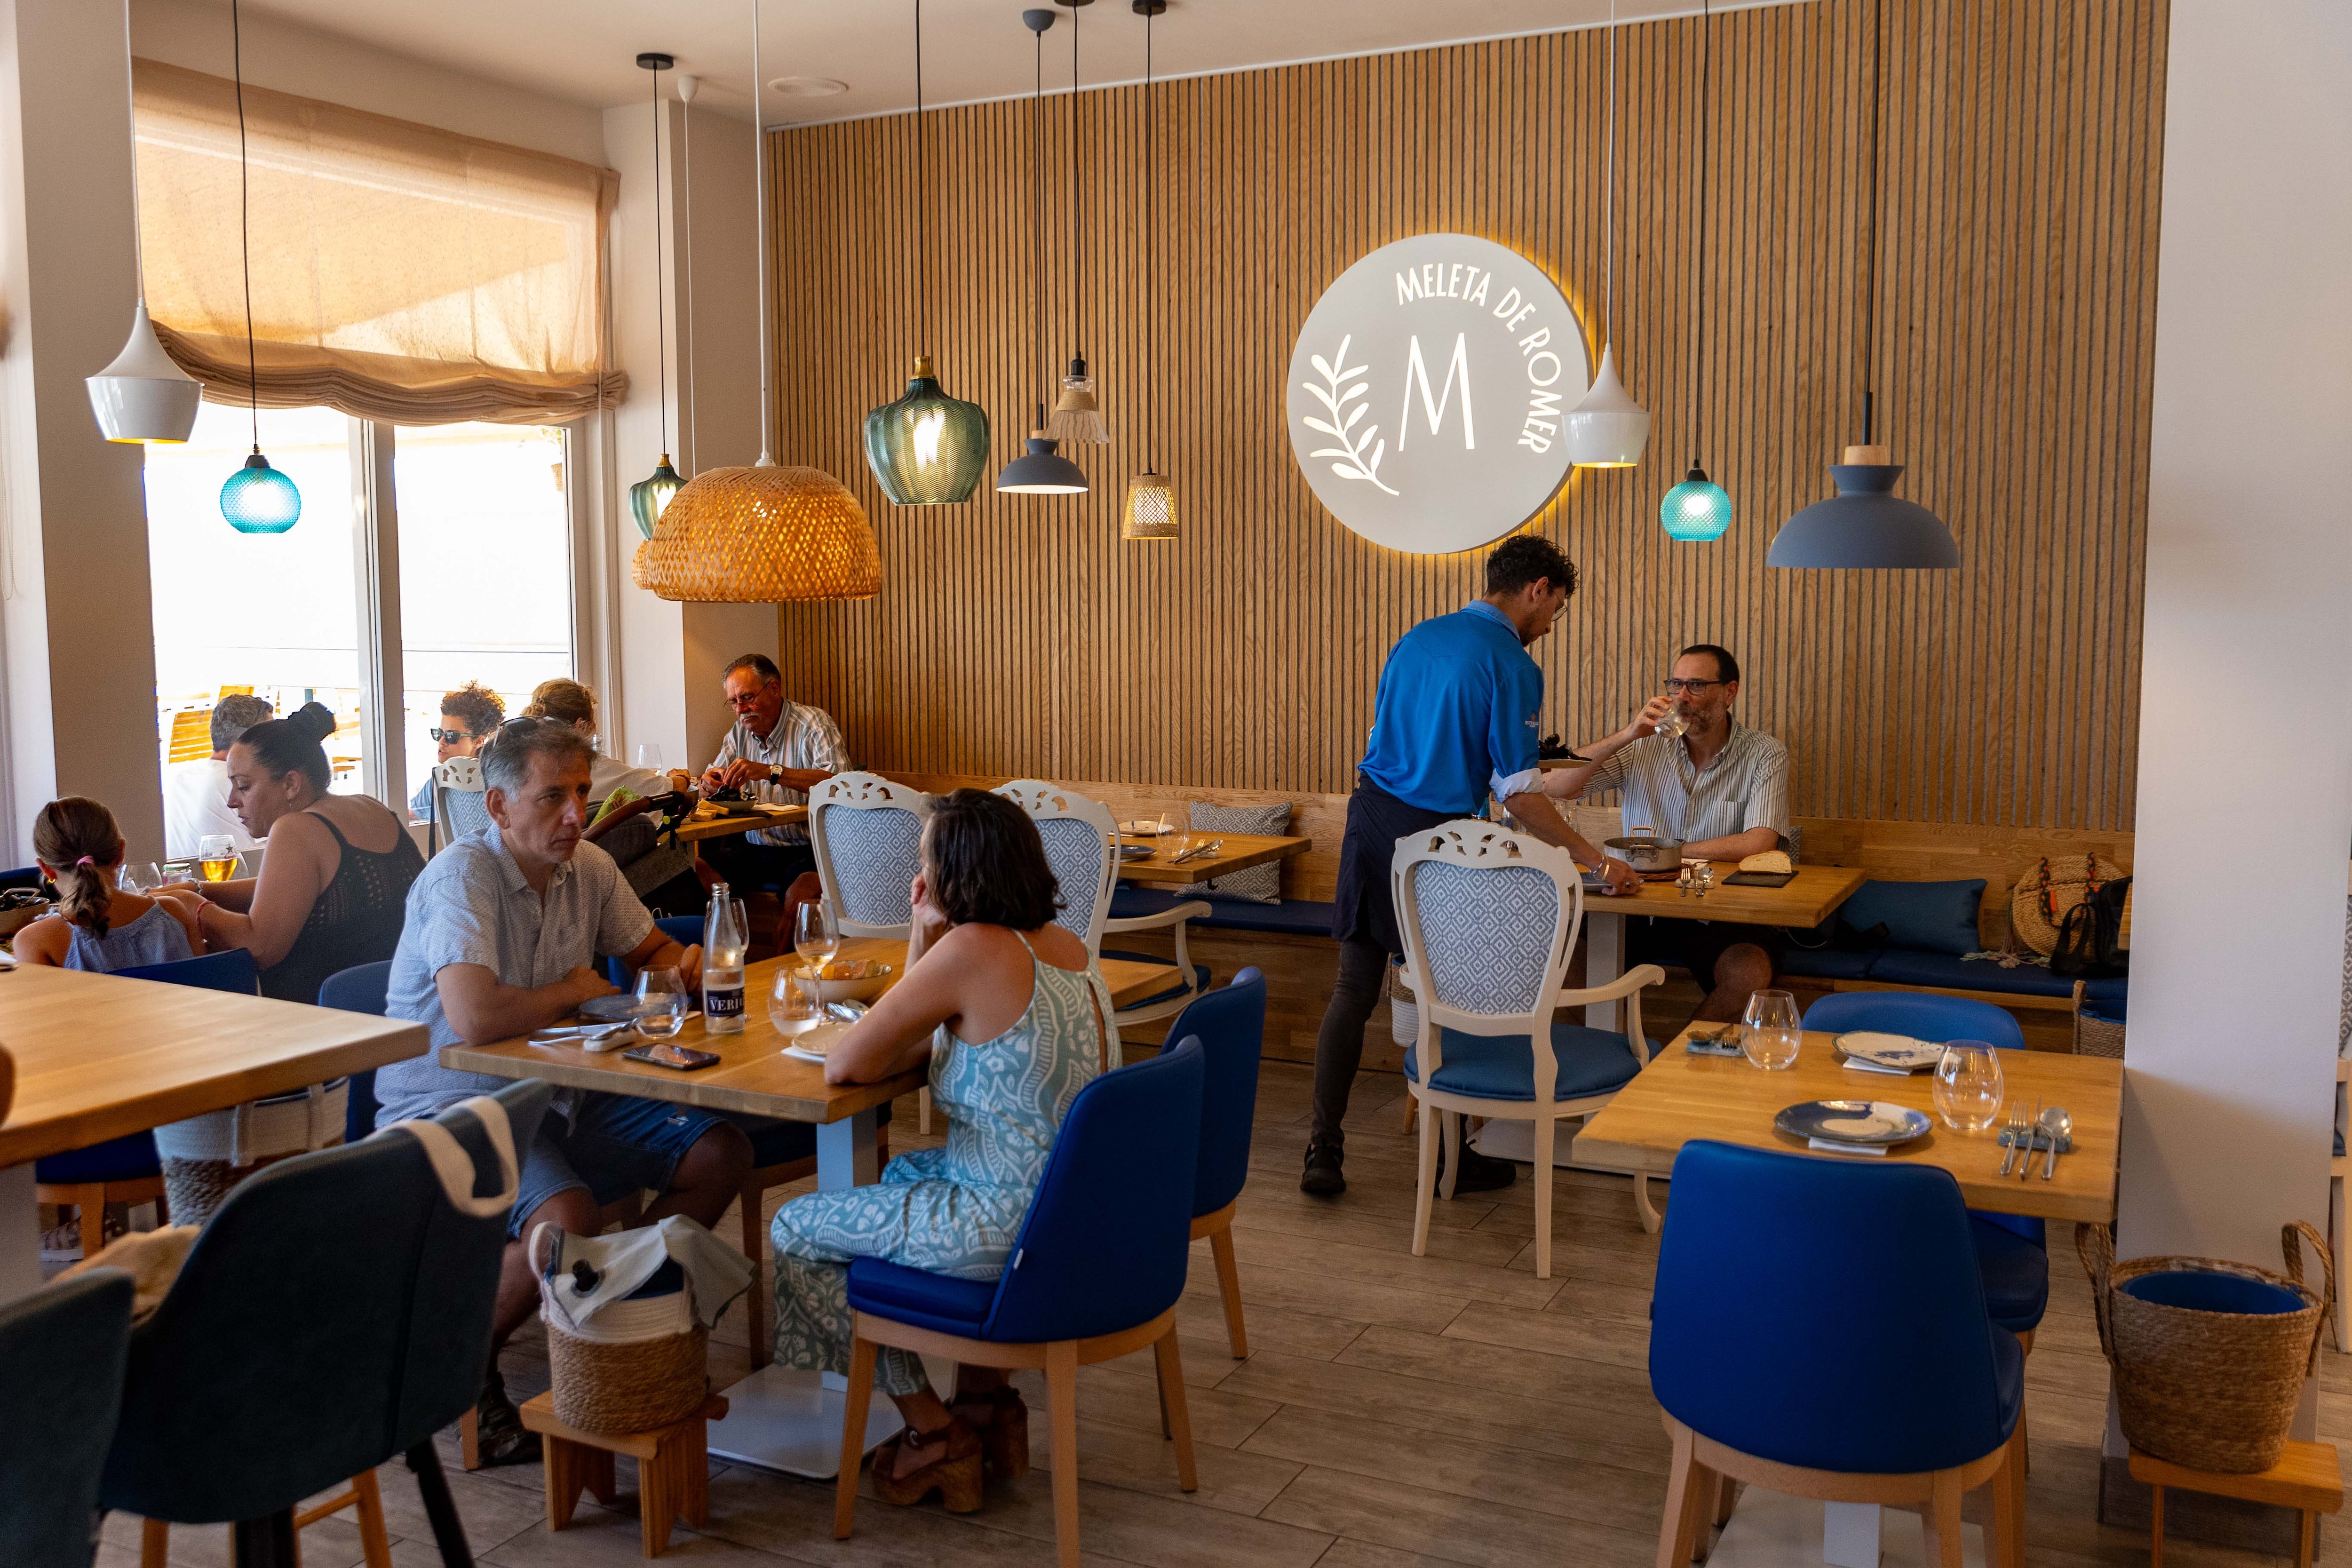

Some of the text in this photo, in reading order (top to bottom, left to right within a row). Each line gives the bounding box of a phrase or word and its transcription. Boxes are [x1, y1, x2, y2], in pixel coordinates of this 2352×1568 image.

[1396, 263, 1562, 453] MELETA DE ROMER
[1398, 333, 1475, 452] M
